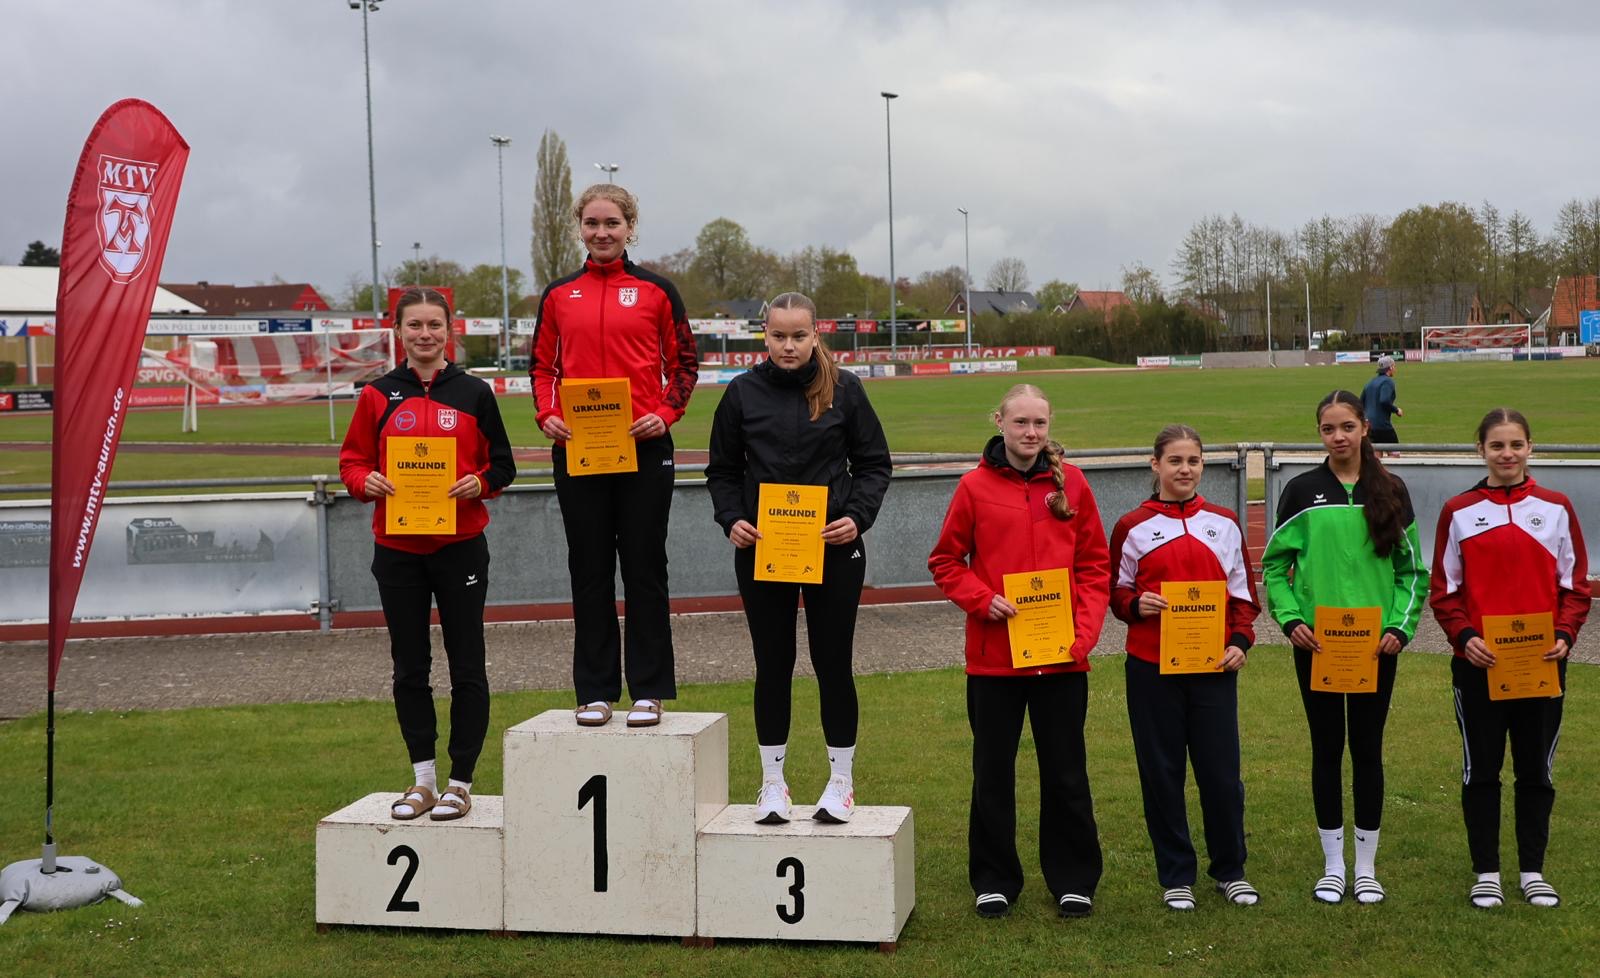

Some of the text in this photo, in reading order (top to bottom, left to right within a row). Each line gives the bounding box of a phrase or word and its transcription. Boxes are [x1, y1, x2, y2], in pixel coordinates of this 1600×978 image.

[102, 161, 156, 189] MTV
[138, 369, 175, 382] SPVG
[572, 403, 621, 413] URKUNDE
[397, 461, 446, 470] URKUNDE
[72, 386, 124, 568] www.mtv-aurich.de
[768, 508, 817, 518] URKUNDE
[1015, 592, 1062, 605] URKUNDE
[1171, 604, 1217, 613] URKUNDE
[1324, 629, 1371, 637] URKUNDE
[1495, 633, 1545, 645] URKUNDE
[578, 775, 607, 892] 1
[386, 845, 420, 912] 2
[776, 857, 804, 924] 3
